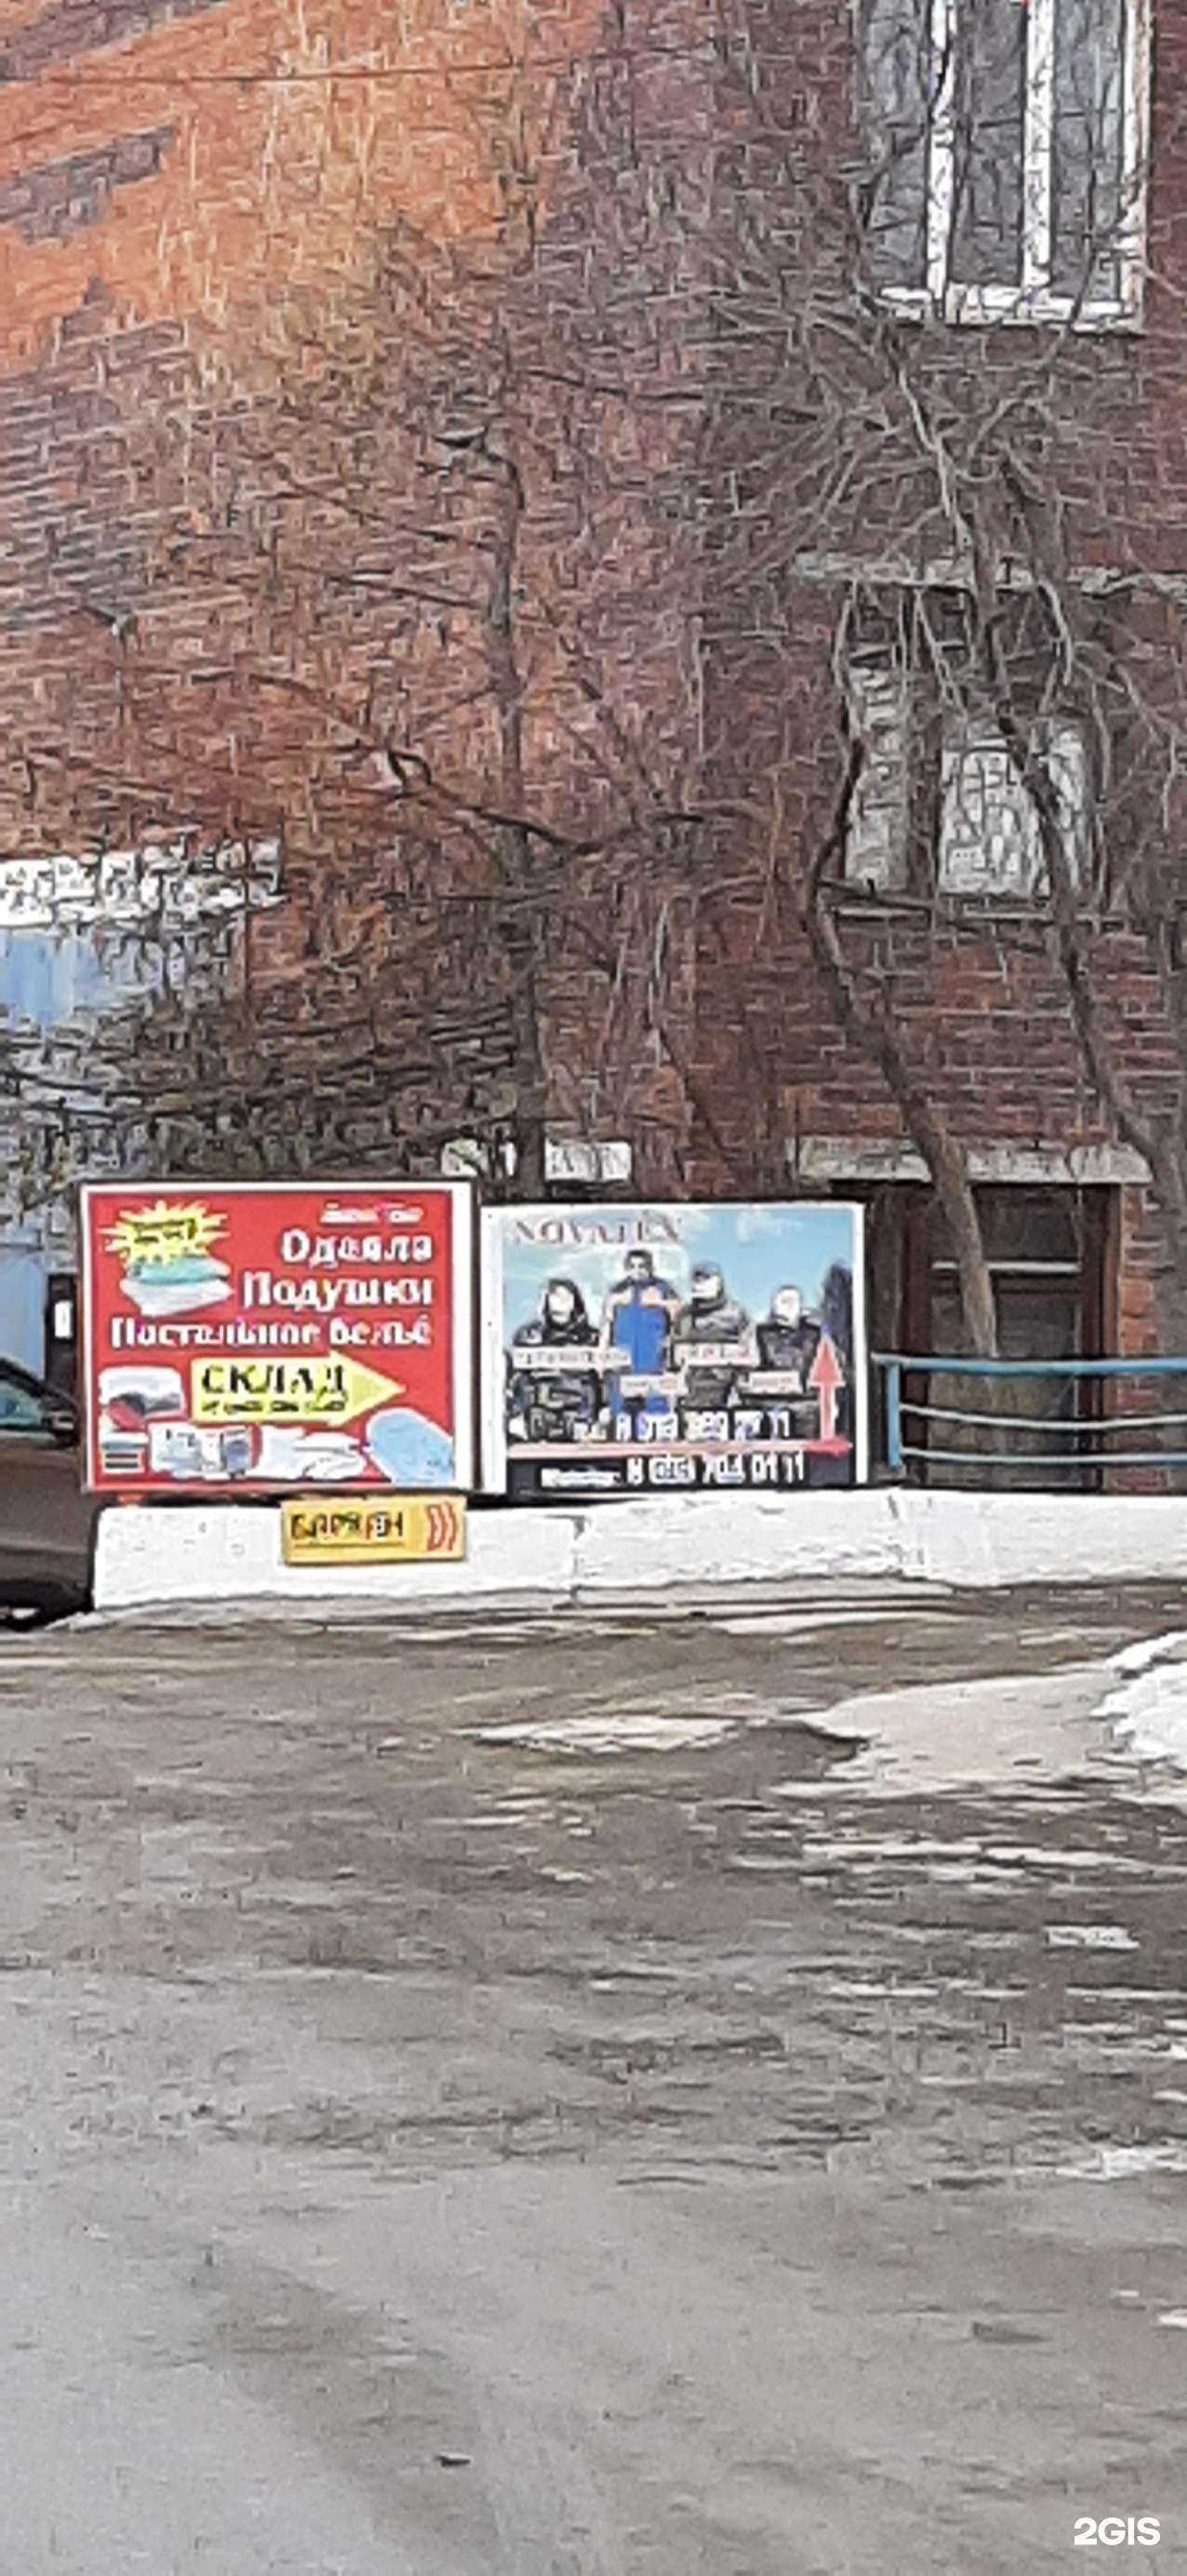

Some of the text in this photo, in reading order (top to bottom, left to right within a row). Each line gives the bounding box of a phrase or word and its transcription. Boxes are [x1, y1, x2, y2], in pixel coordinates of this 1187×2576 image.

[281, 1228, 433, 1269] Одеяла
[243, 1271, 433, 1312] Подушки
[201, 1363, 350, 1402] СКЛАД
